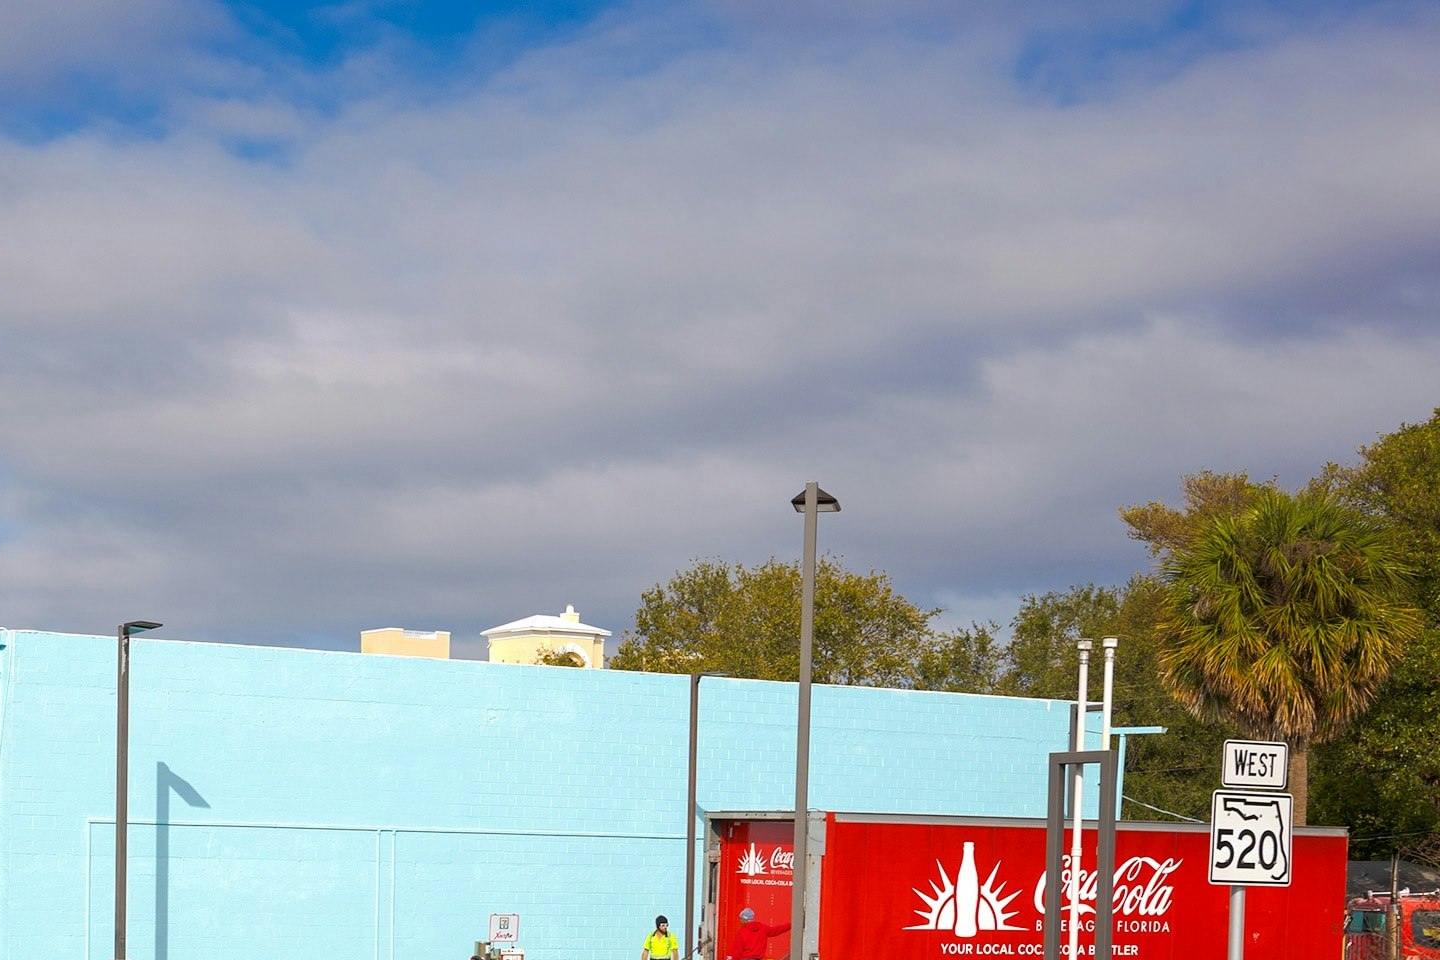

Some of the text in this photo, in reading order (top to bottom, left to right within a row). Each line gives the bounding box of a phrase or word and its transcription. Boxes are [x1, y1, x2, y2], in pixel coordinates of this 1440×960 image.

[1234, 749, 1277, 778] WEST
[1215, 828, 1278, 871] 520
[1116, 920, 1171, 933] FLORIDA
[940, 943, 974, 955] YOUR
[976, 943, 1015, 956] LOCAL
[1088, 944, 1139, 956] BTLER
